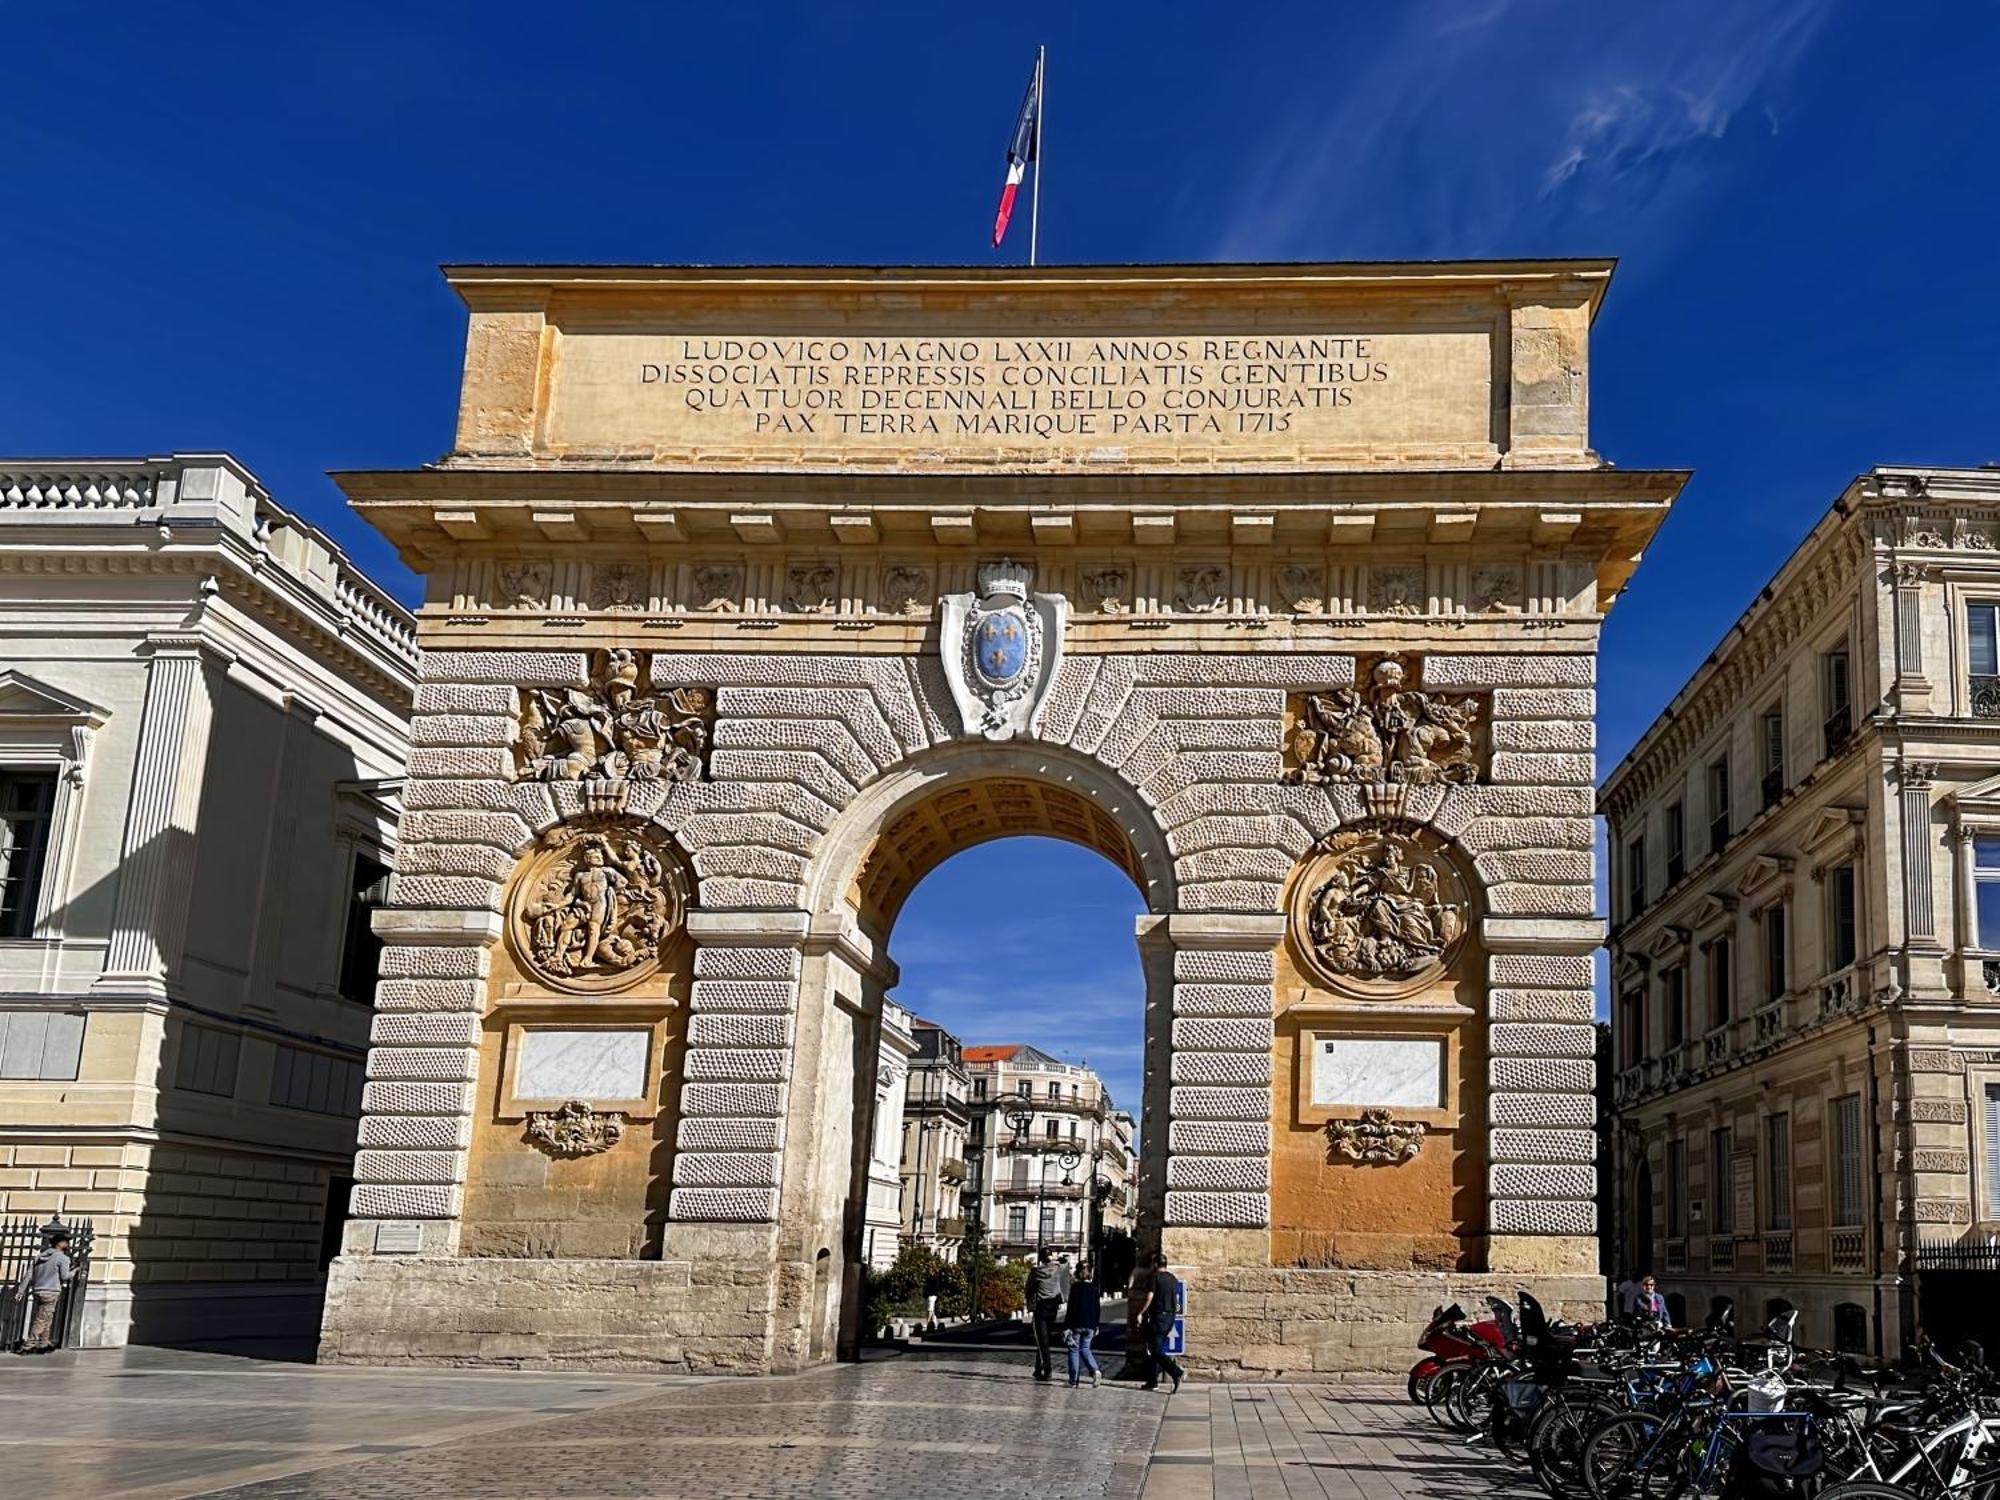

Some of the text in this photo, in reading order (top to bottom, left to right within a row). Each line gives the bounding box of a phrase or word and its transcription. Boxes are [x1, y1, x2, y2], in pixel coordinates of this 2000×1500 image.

[684, 339, 1371, 361] LUDOVICO MAGNO LXXII ANNOS REGNANTE
[641, 362, 1388, 386] DISSOCIATIS REPRESSIS CONCILIATIS GENTIBUS
[684, 387, 1353, 411] QUATUOR DECENNALI BELLO CONJURATIS
[756, 413, 817, 434] PAX
[834, 413, 940, 434] TERRA
[956, 413, 1097, 439] MARIQUE
[1113, 413, 1222, 434] PARTA
